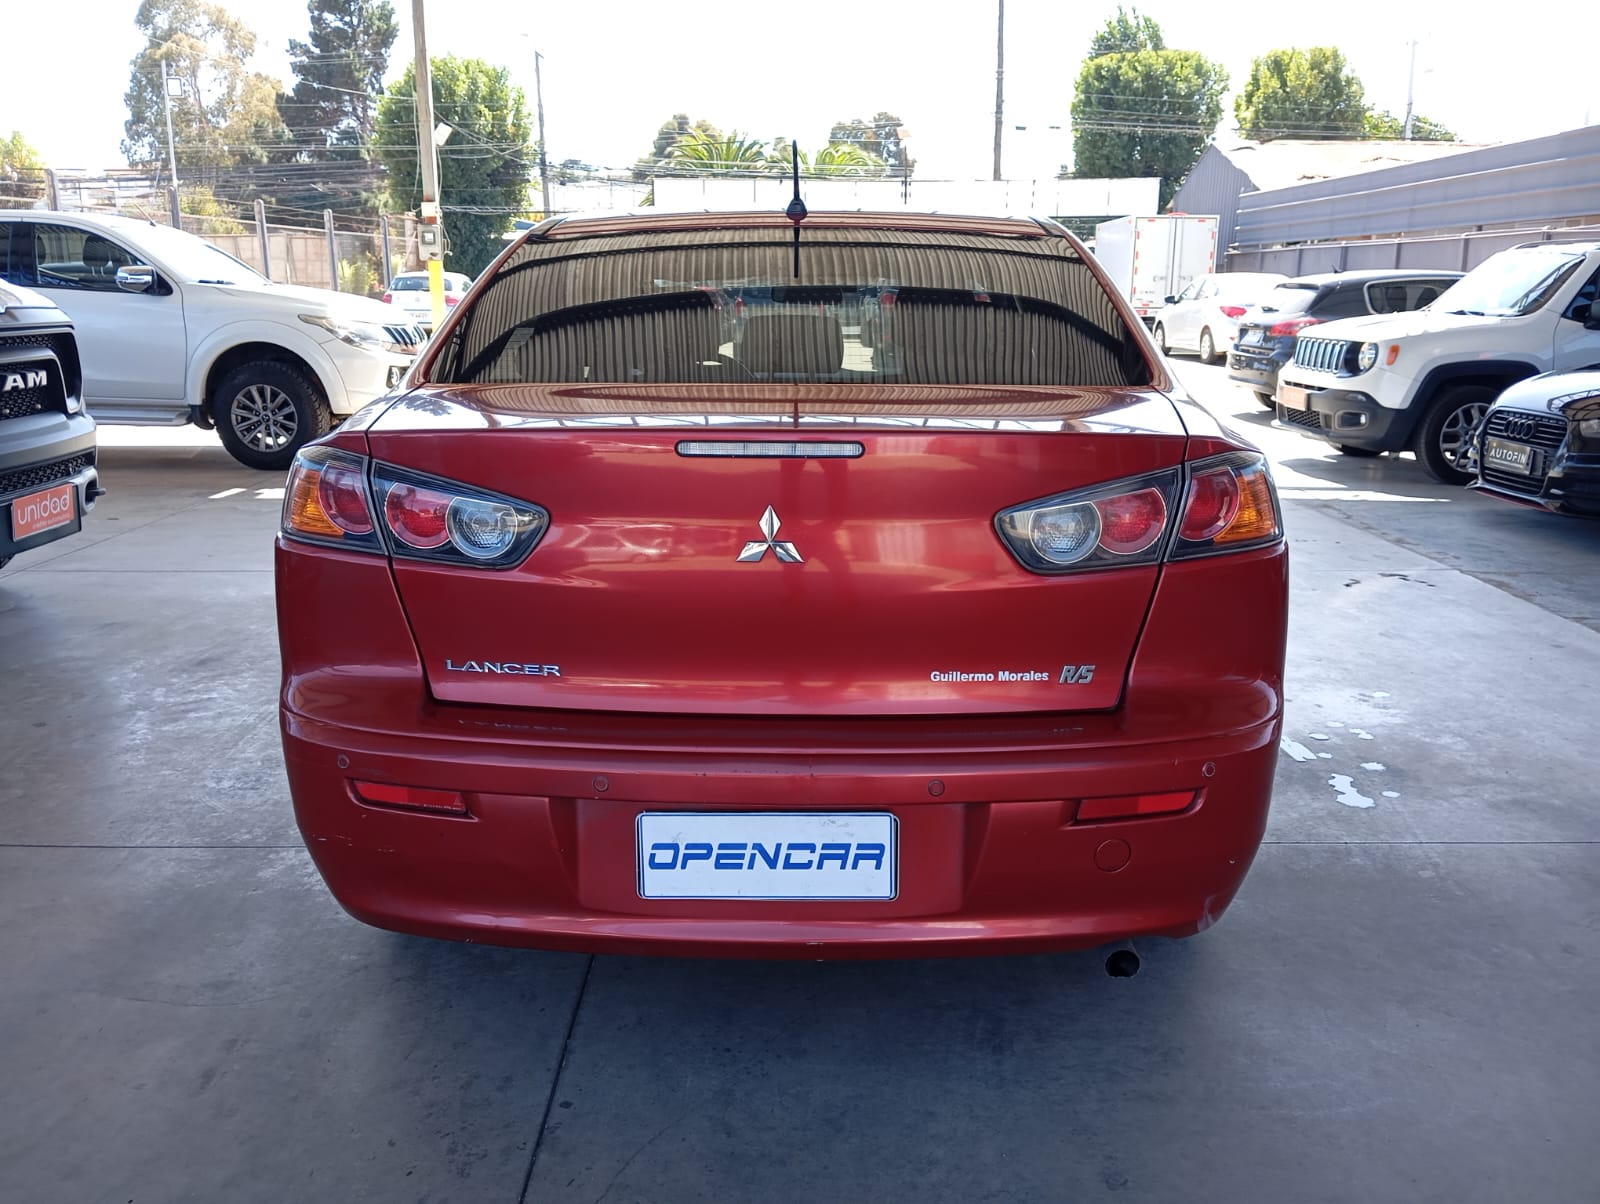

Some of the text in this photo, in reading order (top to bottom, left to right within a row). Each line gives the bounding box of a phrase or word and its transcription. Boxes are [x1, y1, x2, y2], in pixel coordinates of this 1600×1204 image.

[1490, 448, 1528, 464] AUTOFIN
[17, 488, 70, 525] unidad
[446, 660, 561, 676] LANCER
[930, 671, 1049, 682] Guillermo Morales
[649, 843, 886, 870] OPENCAR
